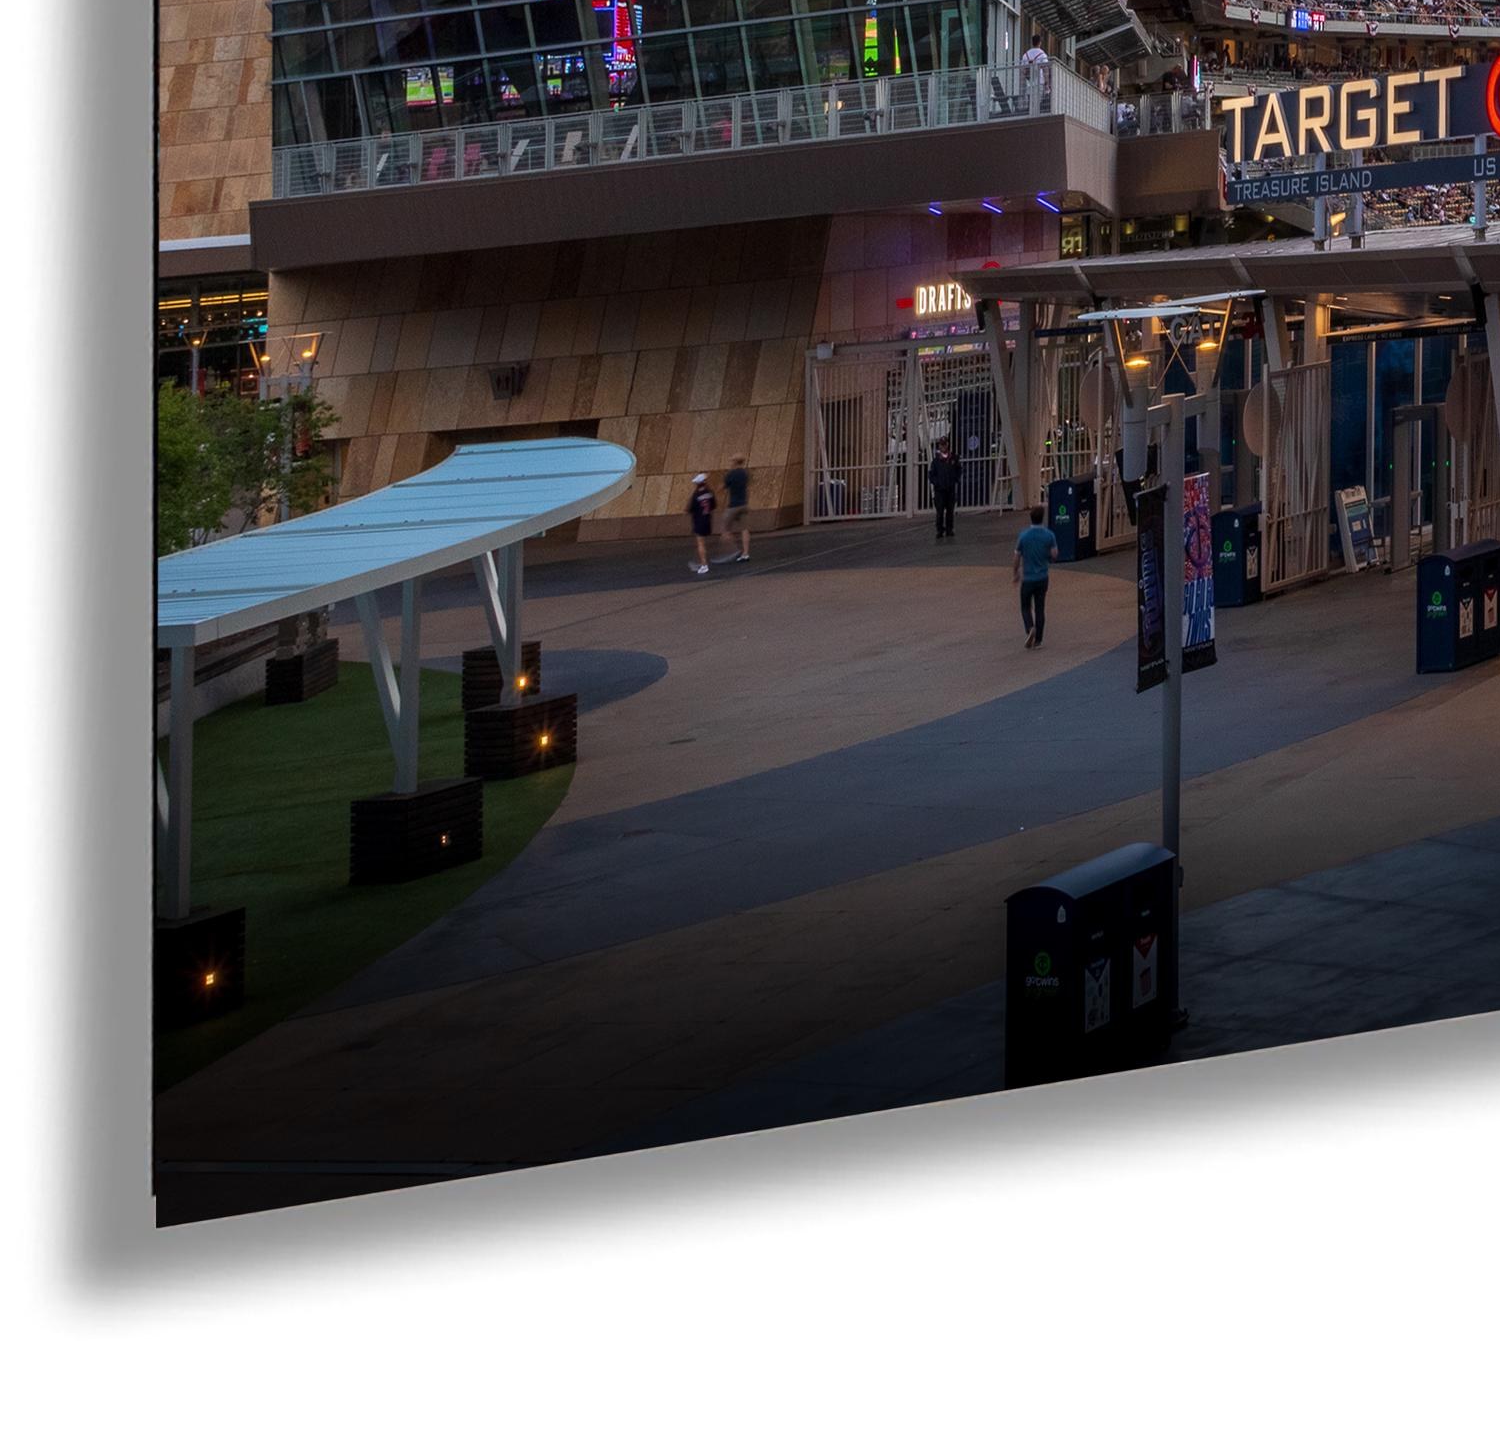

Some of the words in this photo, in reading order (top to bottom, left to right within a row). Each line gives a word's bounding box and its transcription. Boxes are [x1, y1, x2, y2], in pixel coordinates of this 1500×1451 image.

[1222, 66, 1465, 163] TARGET
[1474, 157, 1497, 176] US
[1234, 177, 1310, 200] TREASURE
[1316, 170, 1373, 193] ISLAND
